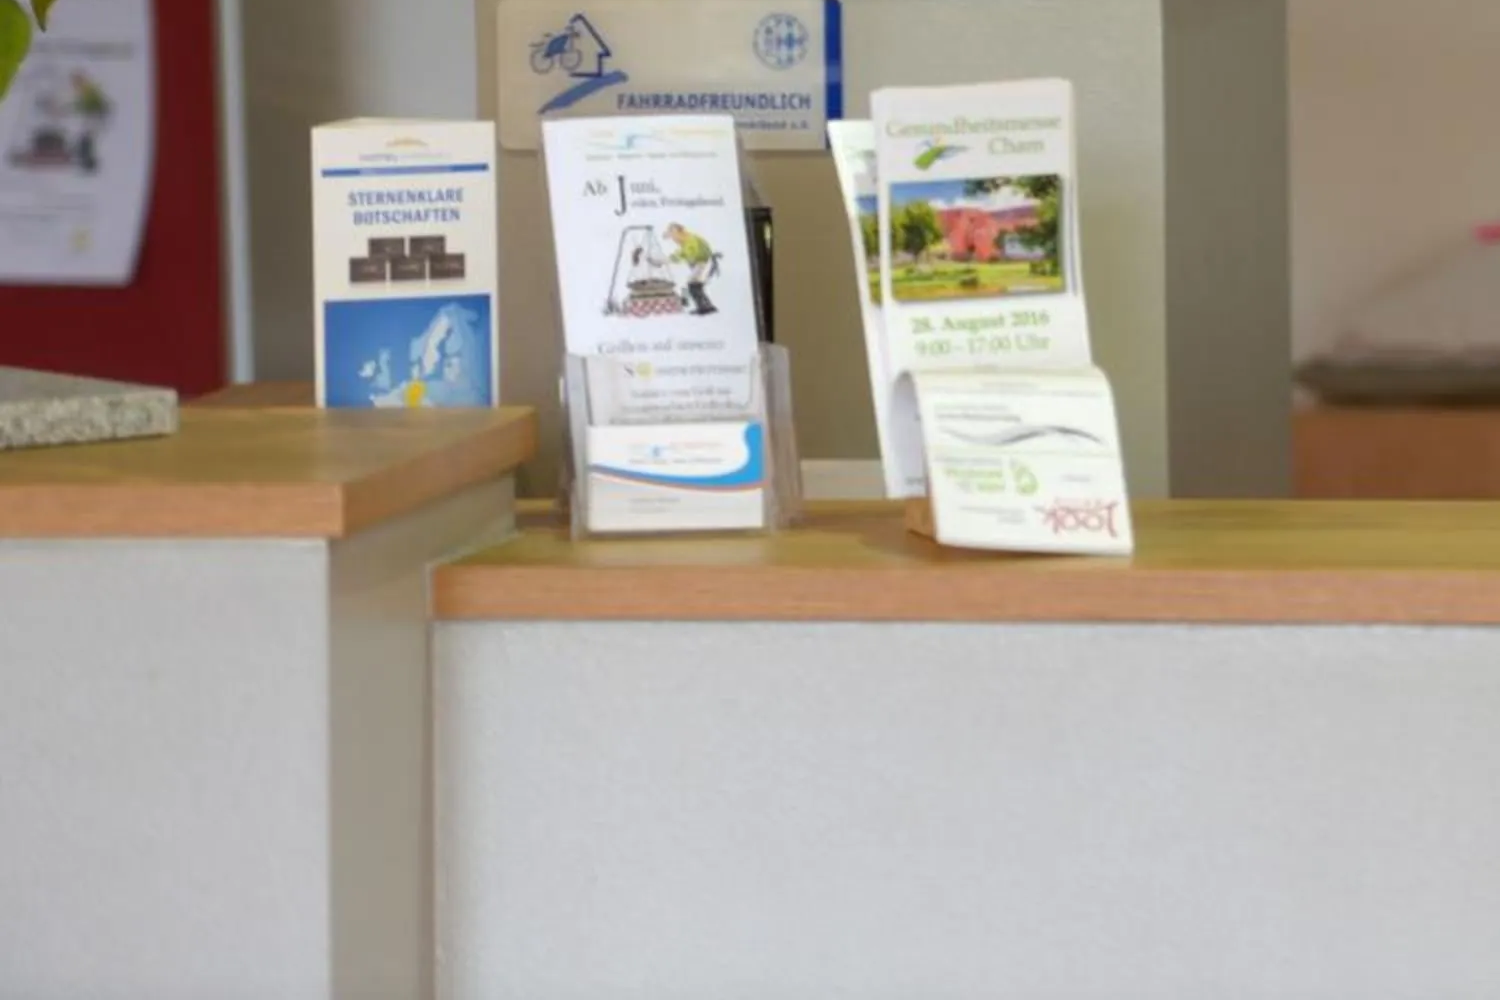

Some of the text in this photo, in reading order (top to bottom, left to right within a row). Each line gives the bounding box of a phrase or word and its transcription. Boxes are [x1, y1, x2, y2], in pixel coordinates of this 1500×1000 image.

[616, 90, 812, 112] FAHRRADFREUNDLICH
[987, 136, 1046, 156] Cham
[347, 186, 465, 207] STERNENKLARE
[583, 180, 608, 197] Ab
[352, 207, 462, 226] BOTSCHAFTEN
[941, 313, 1004, 333] August
[1010, 310, 1051, 328] 2016
[1015, 332, 1051, 350] Uhr
